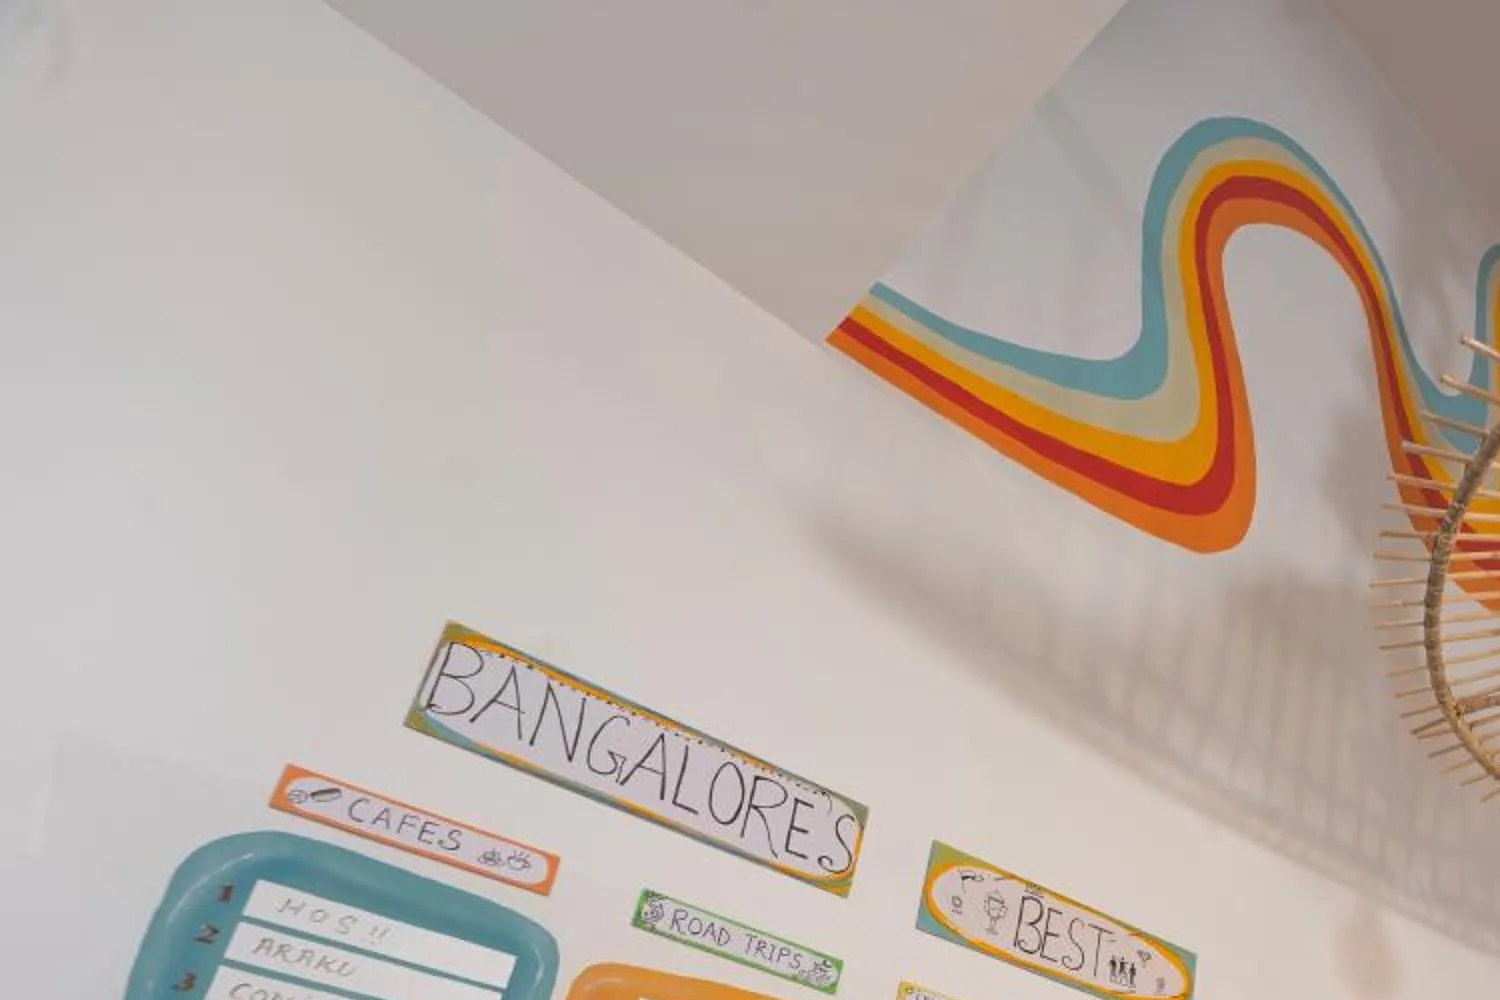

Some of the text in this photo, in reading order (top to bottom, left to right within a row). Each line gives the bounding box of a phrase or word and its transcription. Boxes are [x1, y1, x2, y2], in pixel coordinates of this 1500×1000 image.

[424, 640, 856, 875] BANGALORE'S
[347, 797, 464, 852] CAFES
[252, 937, 359, 977] ARAKU
[670, 909, 804, 970] ROAD TRIPS
[1012, 895, 1117, 979] BEST
